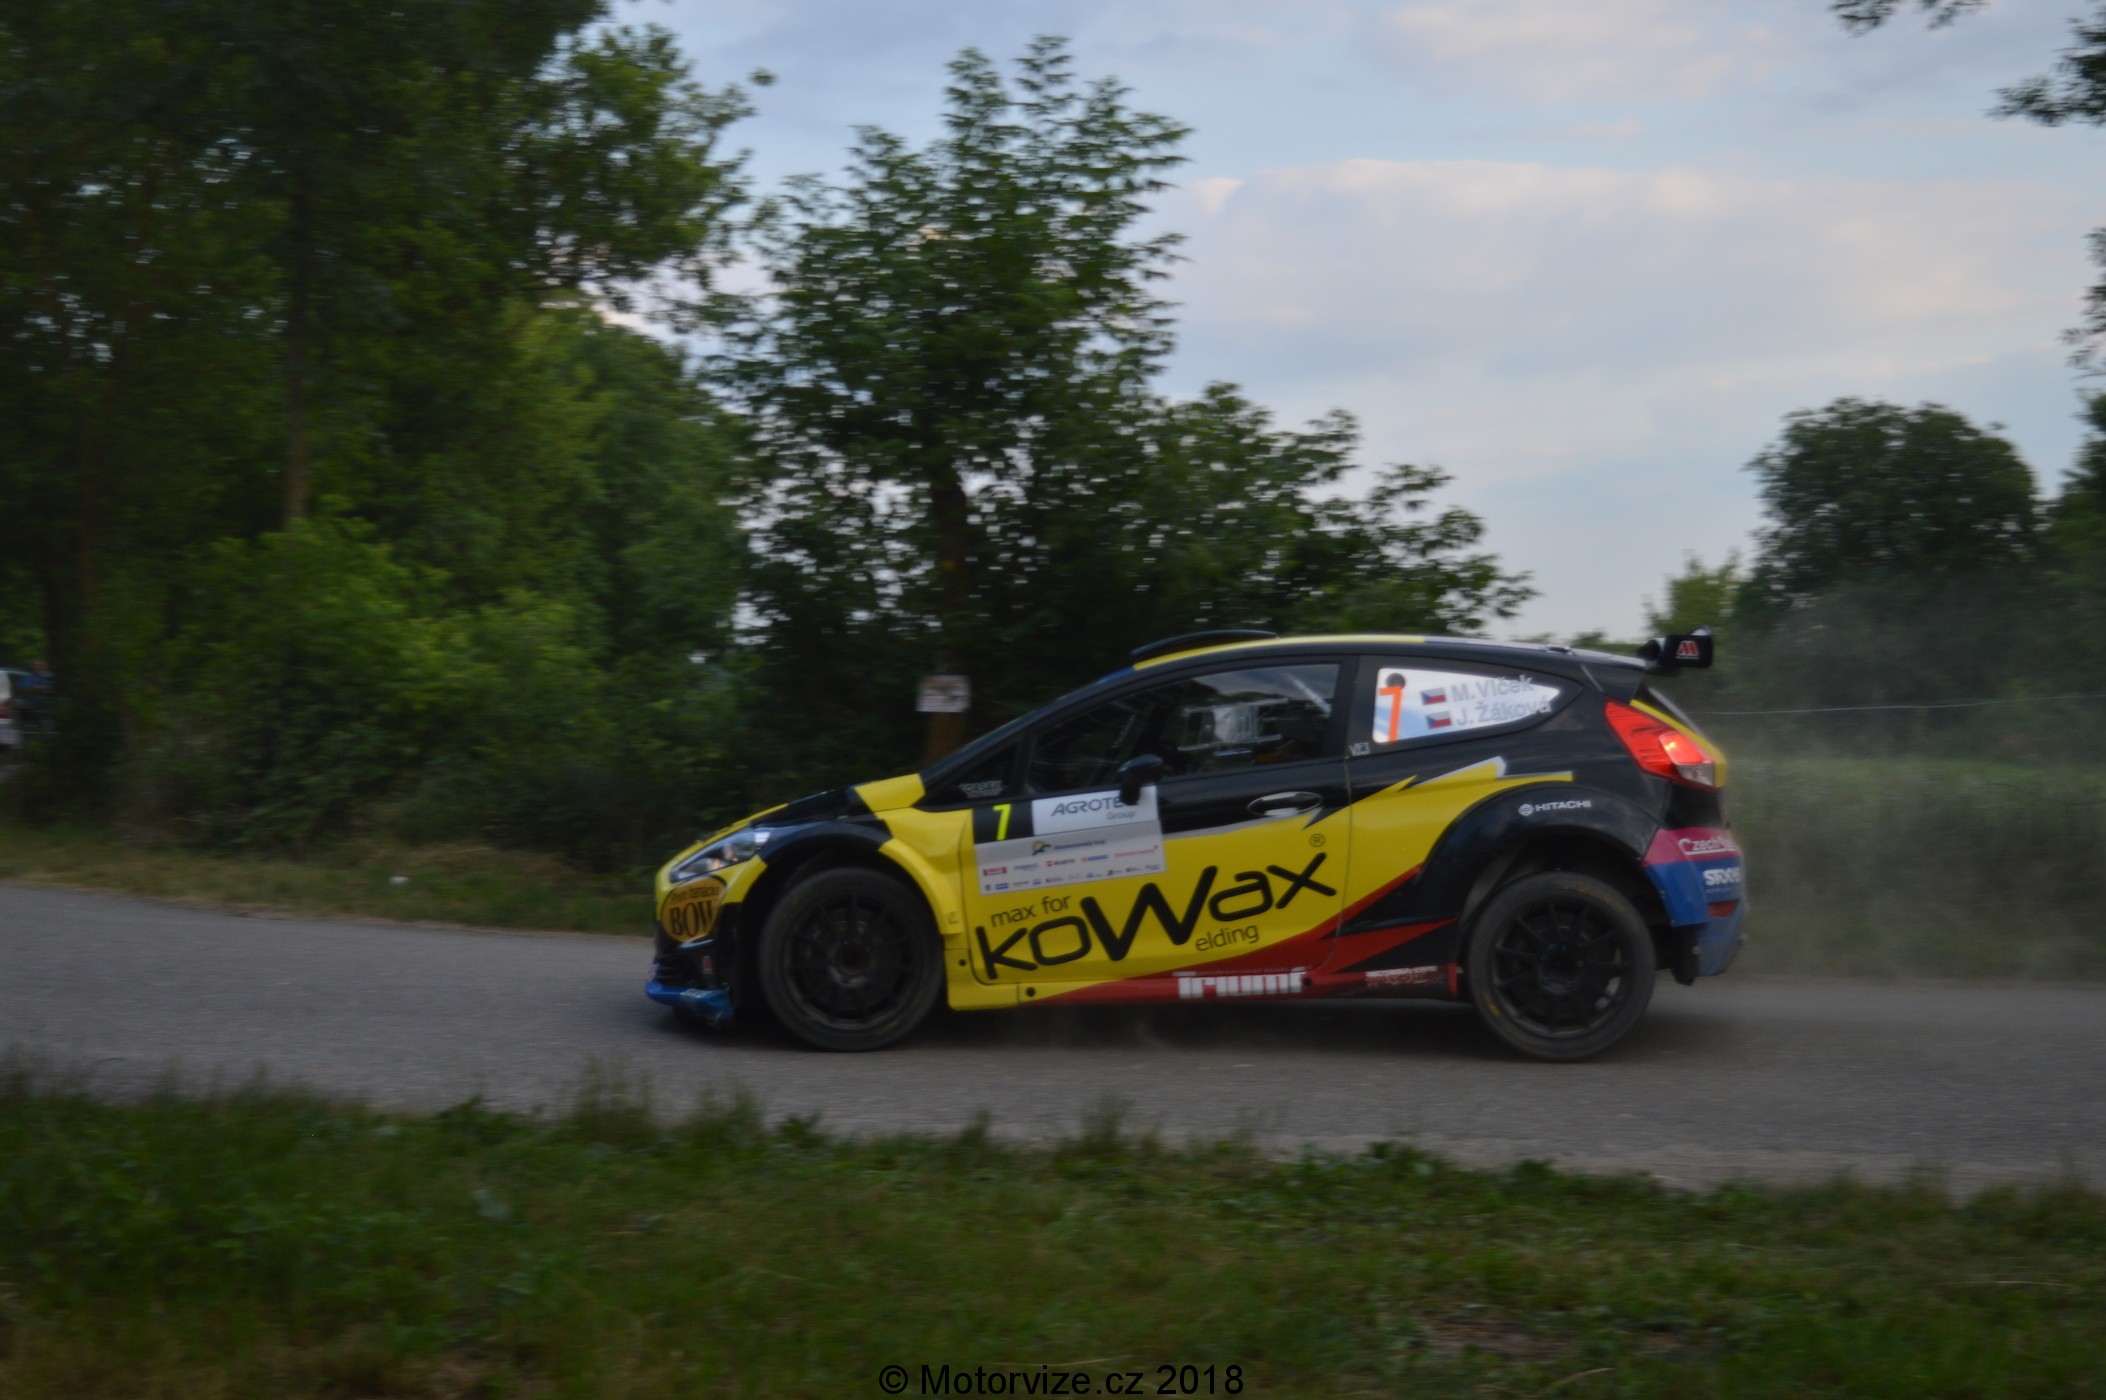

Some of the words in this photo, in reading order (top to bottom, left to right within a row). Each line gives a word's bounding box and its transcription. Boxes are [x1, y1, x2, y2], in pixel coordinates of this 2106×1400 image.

[1052, 796, 1128, 816] AGROTE
[1106, 811, 1136, 821] Group
[1535, 800, 1592, 812] HITACHI
[992, 803, 1012, 841] 7
[990, 905, 1036, 928] max
[1040, 894, 1071, 914] for
[1195, 925, 1260, 952] elding
